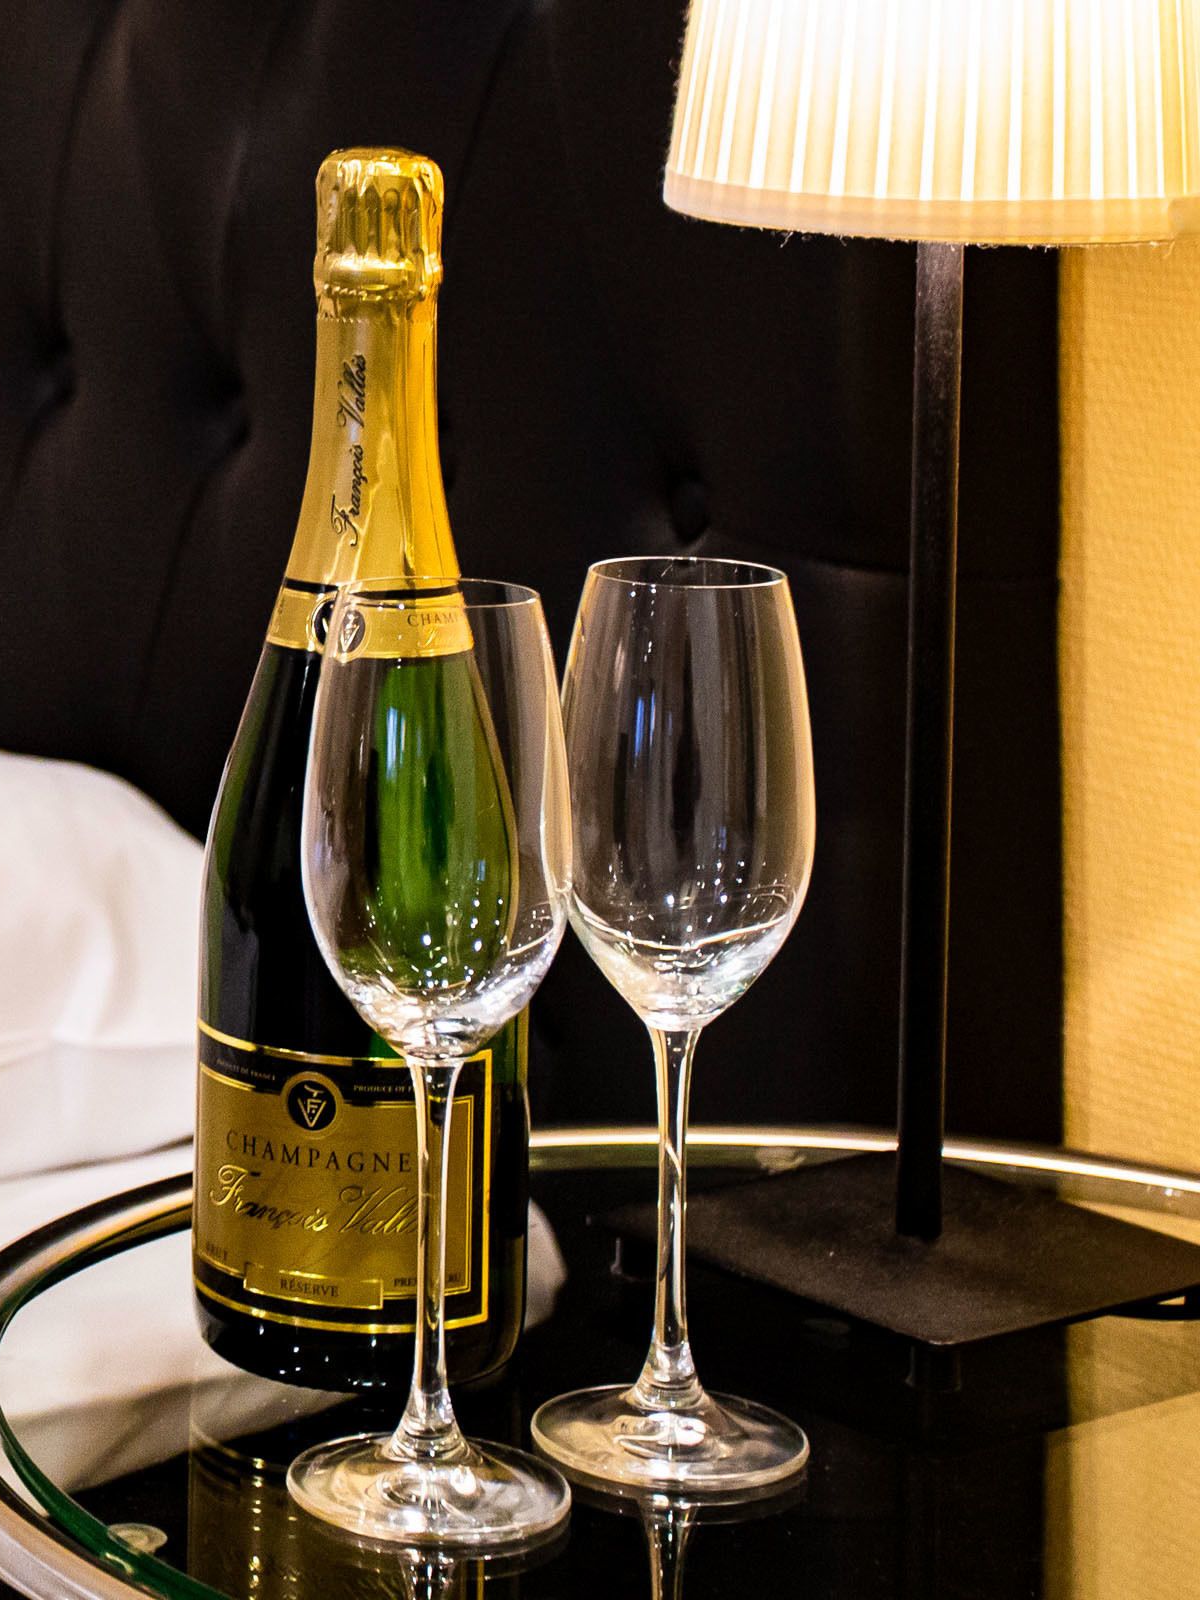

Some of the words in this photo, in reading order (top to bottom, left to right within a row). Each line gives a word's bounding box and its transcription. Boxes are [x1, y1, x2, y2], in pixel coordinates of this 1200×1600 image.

[337, 354, 367, 428] Vallois
[331, 443, 368, 547] François
[227, 1130, 412, 1173] CHAMPAGNE
[210, 1164, 328, 1232] François
[280, 1277, 339, 1297] RÉSERVE
